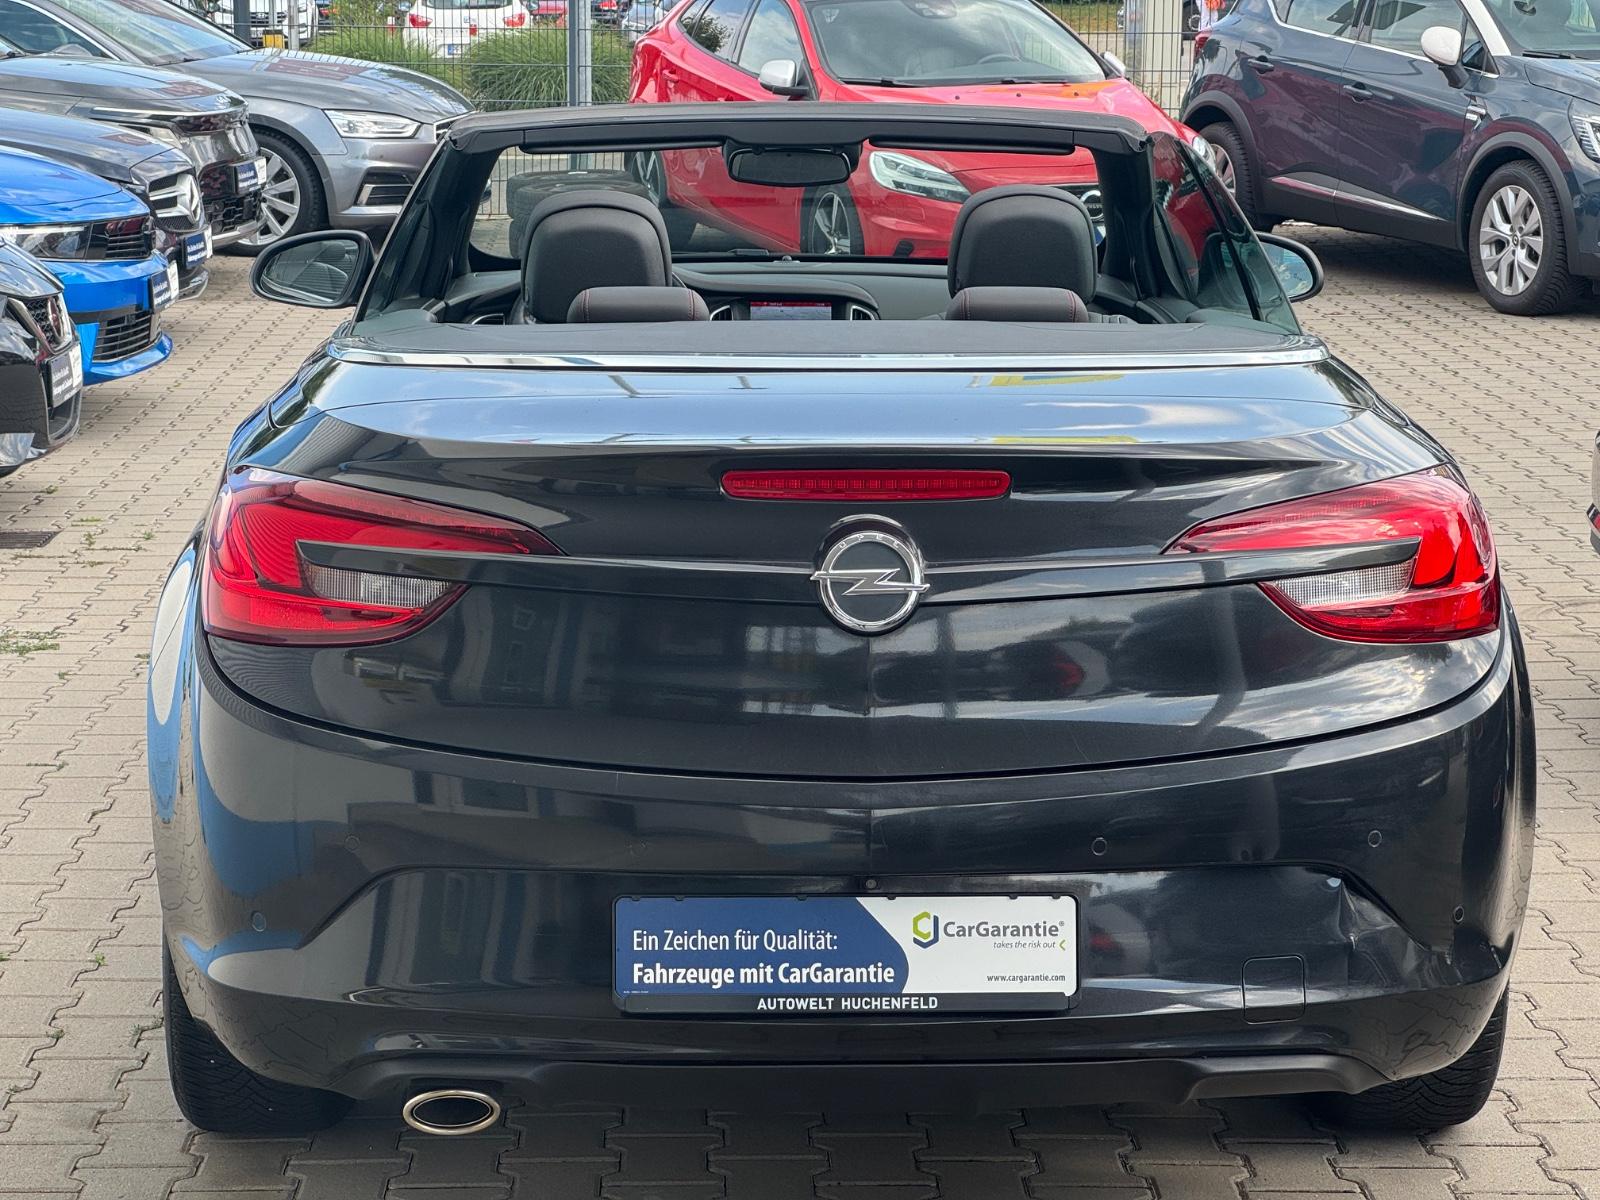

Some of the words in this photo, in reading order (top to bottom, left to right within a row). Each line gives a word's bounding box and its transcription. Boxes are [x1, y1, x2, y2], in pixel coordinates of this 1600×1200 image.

[838, 533, 900, 549] OPEL
[633, 929, 659, 951] Ein
[663, 929, 730, 951] Zeichen
[734, 929, 760, 951] für
[763, 929, 838, 952] Qualität:
[993, 941, 1013, 949] takes
[1014, 940, 1027, 949] the
[1028, 940, 1041, 949] risk
[1042, 941, 1056, 949] out
[633, 962, 735, 989] Fahrzeuge
[740, 962, 774, 984] mit
[778, 962, 895, 984] CarGarantie
[986, 973, 1066, 983] www.cargarantie.com
[757, 997, 835, 1010] AUTOWELT
[841, 996, 938, 1010] HUCHENFELD
